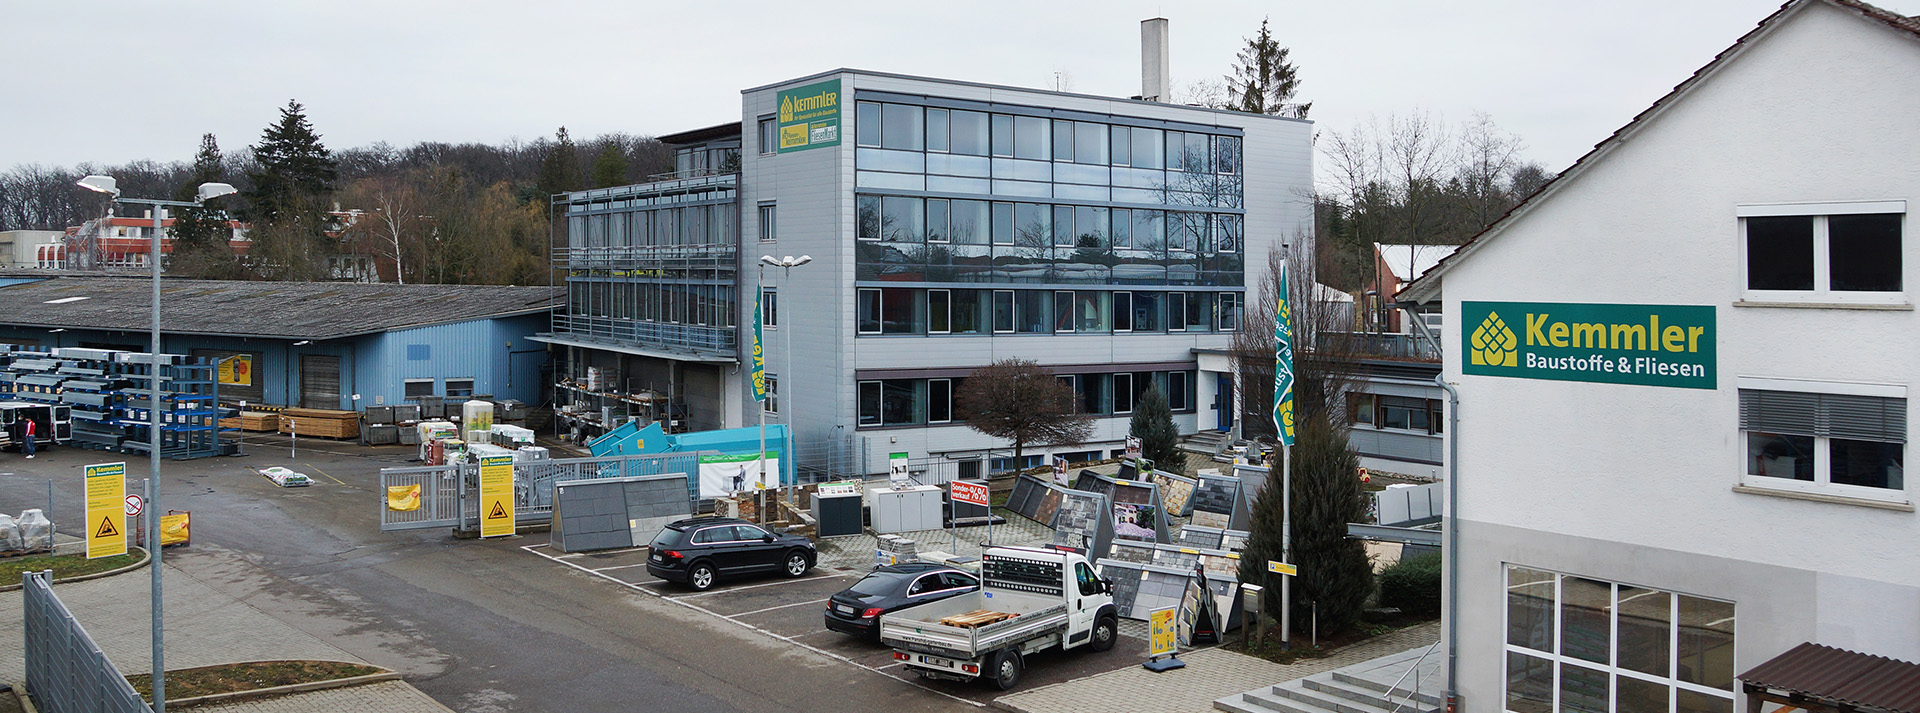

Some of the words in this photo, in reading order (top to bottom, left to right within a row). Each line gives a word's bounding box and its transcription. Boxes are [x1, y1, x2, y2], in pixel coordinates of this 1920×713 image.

[1526, 313, 1704, 353] Kemmler
[1526, 352, 1614, 372] Baustoffe
[1617, 357, 1632, 373] &
[1635, 357, 1705, 377] Fliesen
[96, 465, 123, 473] Kemmler
[952, 483, 970, 492] Sonder-
[952, 492, 970, 500] verkauf
